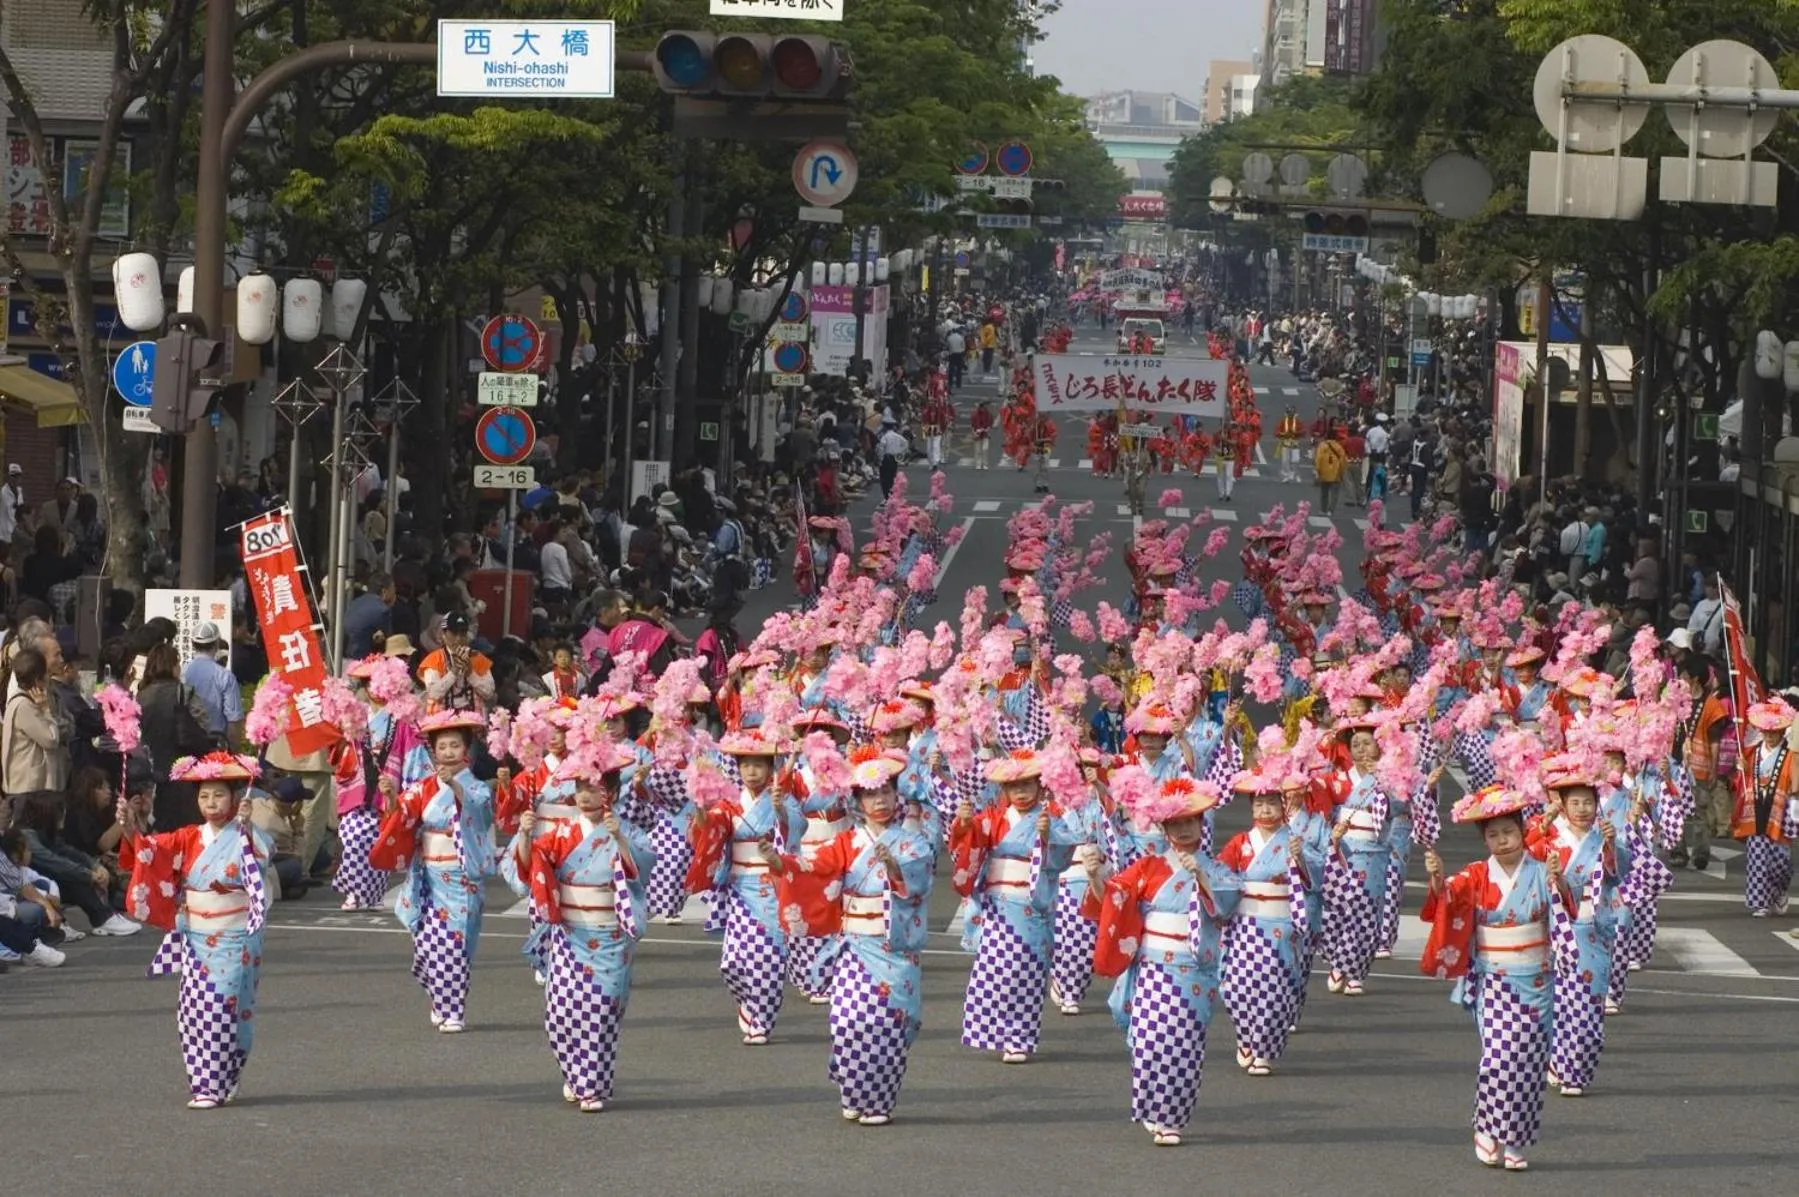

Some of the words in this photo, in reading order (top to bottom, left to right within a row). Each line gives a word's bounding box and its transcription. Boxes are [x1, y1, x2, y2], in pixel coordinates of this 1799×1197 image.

[464, 28, 589, 56] 西大橋
[483, 61, 569, 75] Nishi-ohashi
[486, 77, 565, 88] INTERSECTION
[1041, 362, 1064, 405] コスモス
[1065, 372, 1218, 404] じろ長どんたく隊
[481, 471, 528, 484] 2-16
